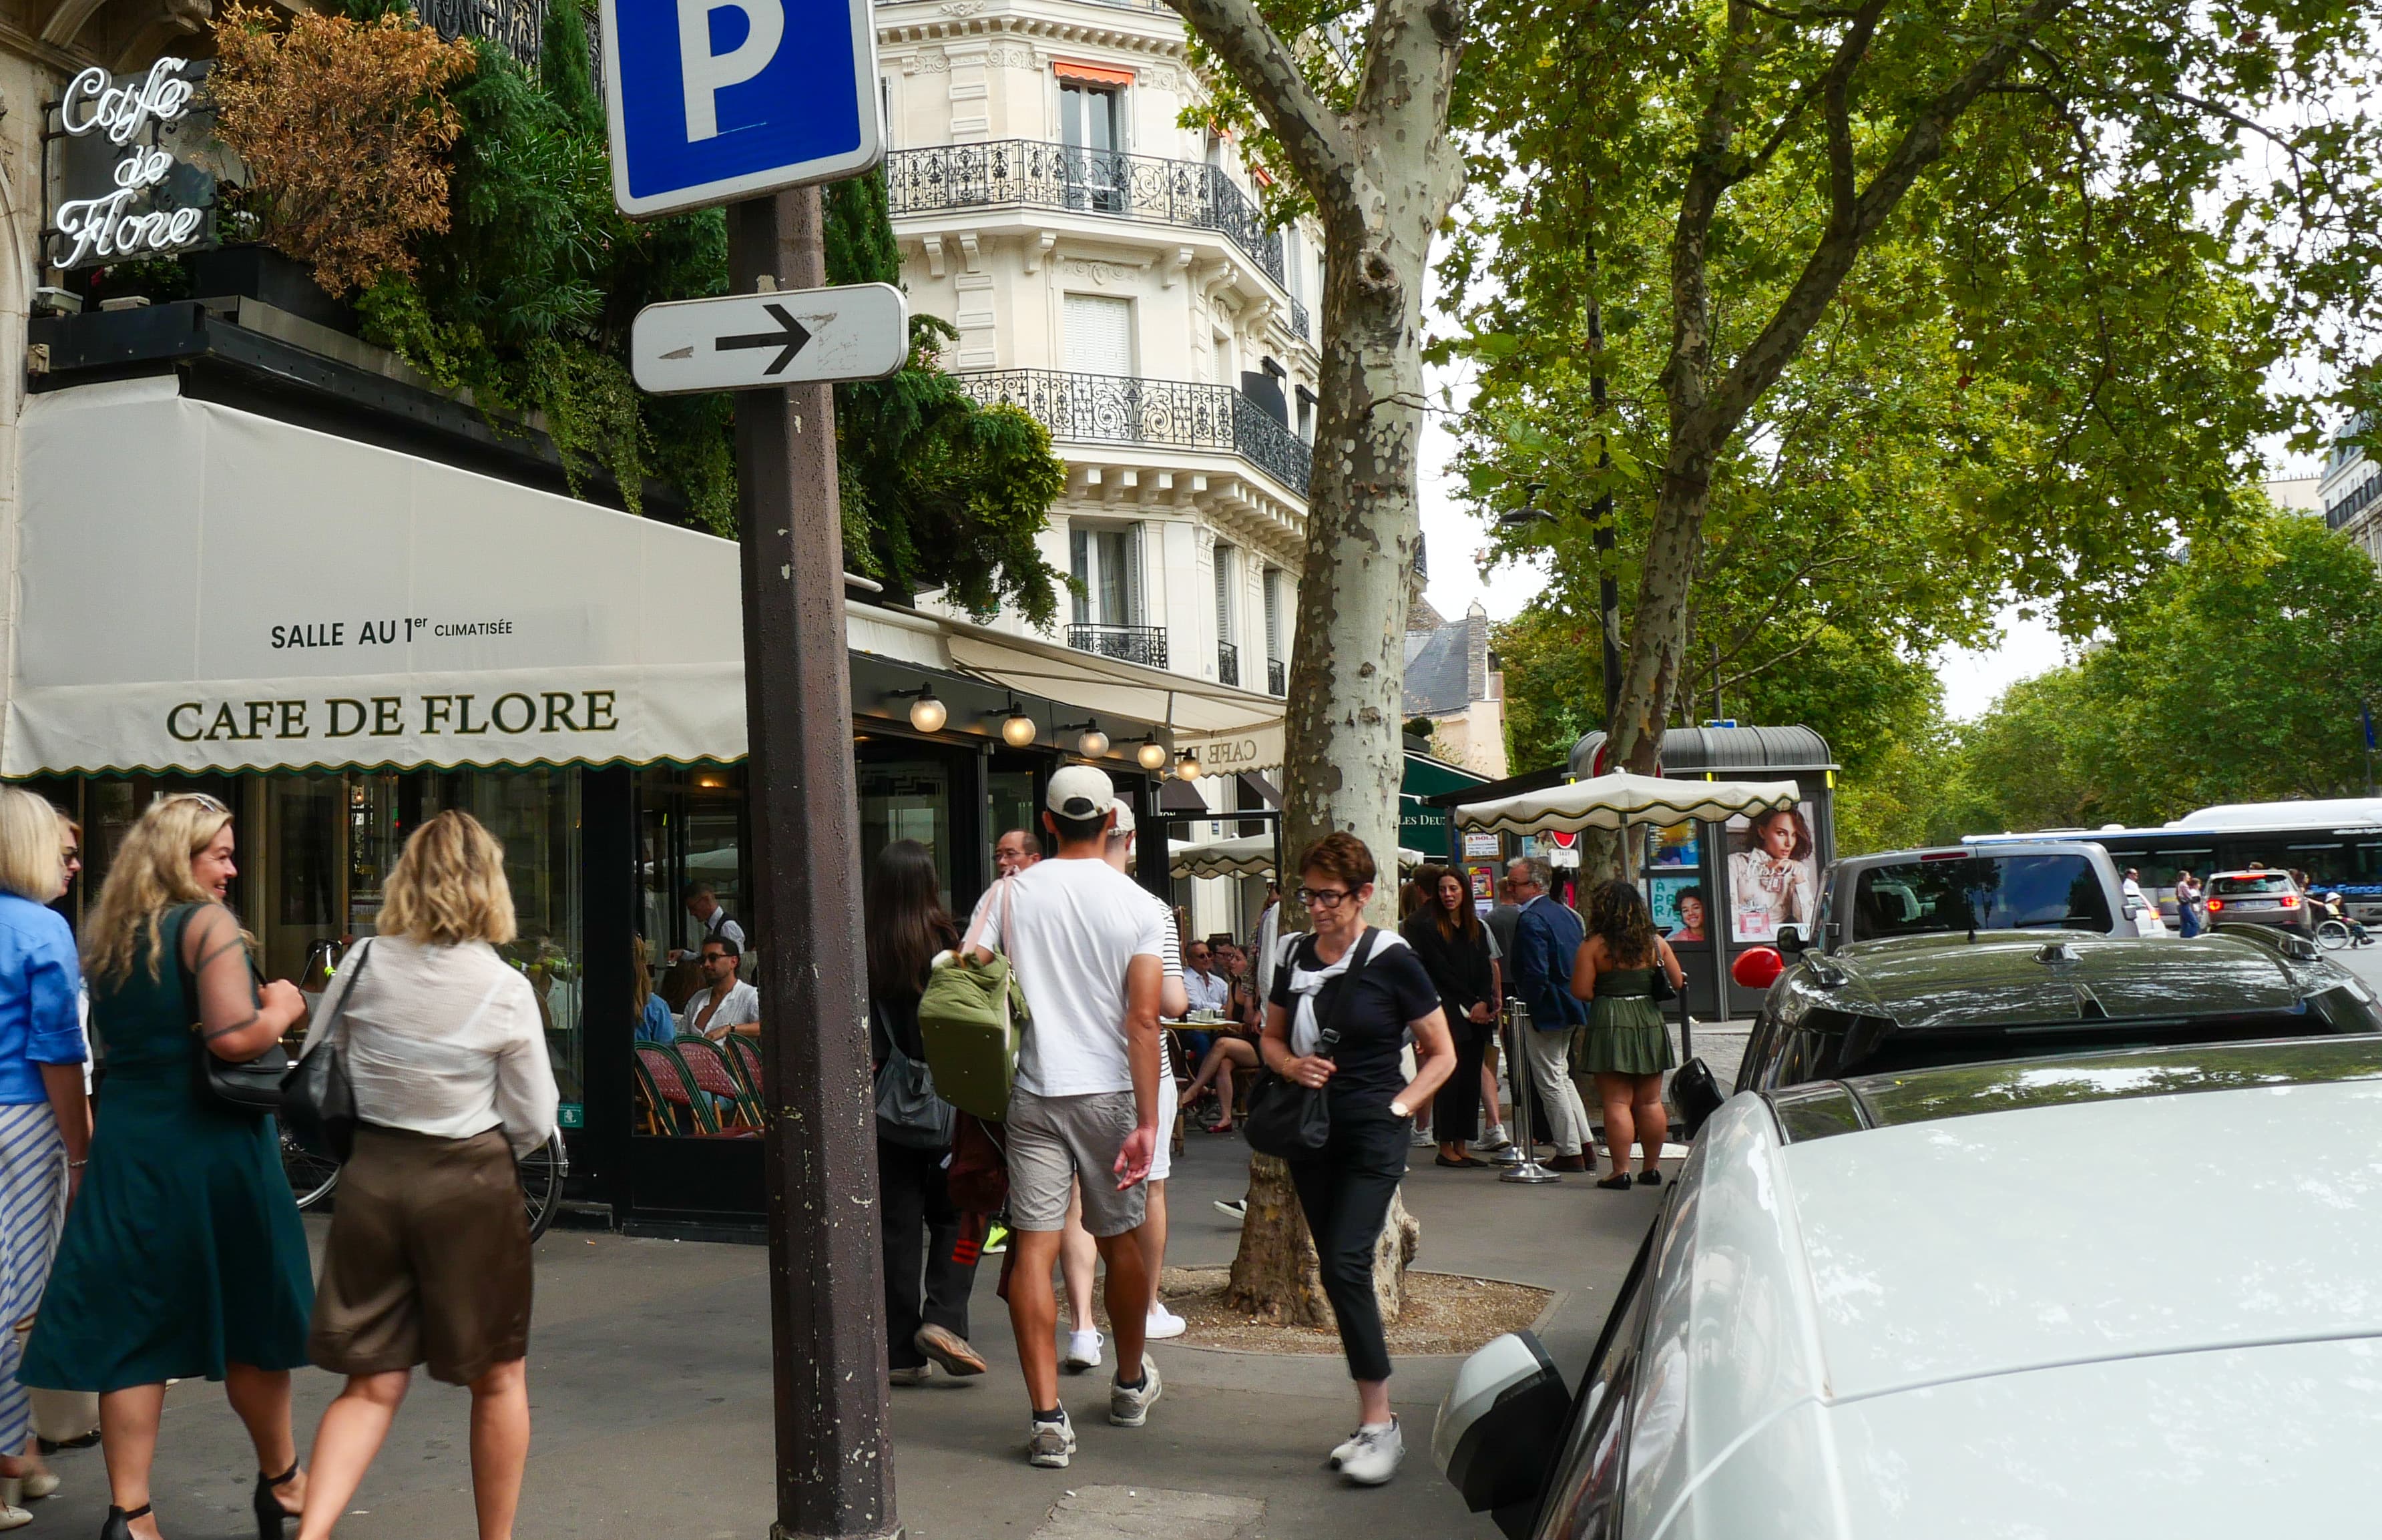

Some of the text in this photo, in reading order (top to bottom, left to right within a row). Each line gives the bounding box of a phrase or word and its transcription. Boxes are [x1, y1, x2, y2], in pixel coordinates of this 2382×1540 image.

[676, 0, 784, 143] P
[114, 145, 173, 188] de
[53, 188, 201, 268] Flore
[270, 622, 344, 649] SALLE
[358, 619, 397, 646] AU
[434, 618, 513, 637] CLIMATISÉE
[166, 690, 620, 742] CAFE DE FLORE
